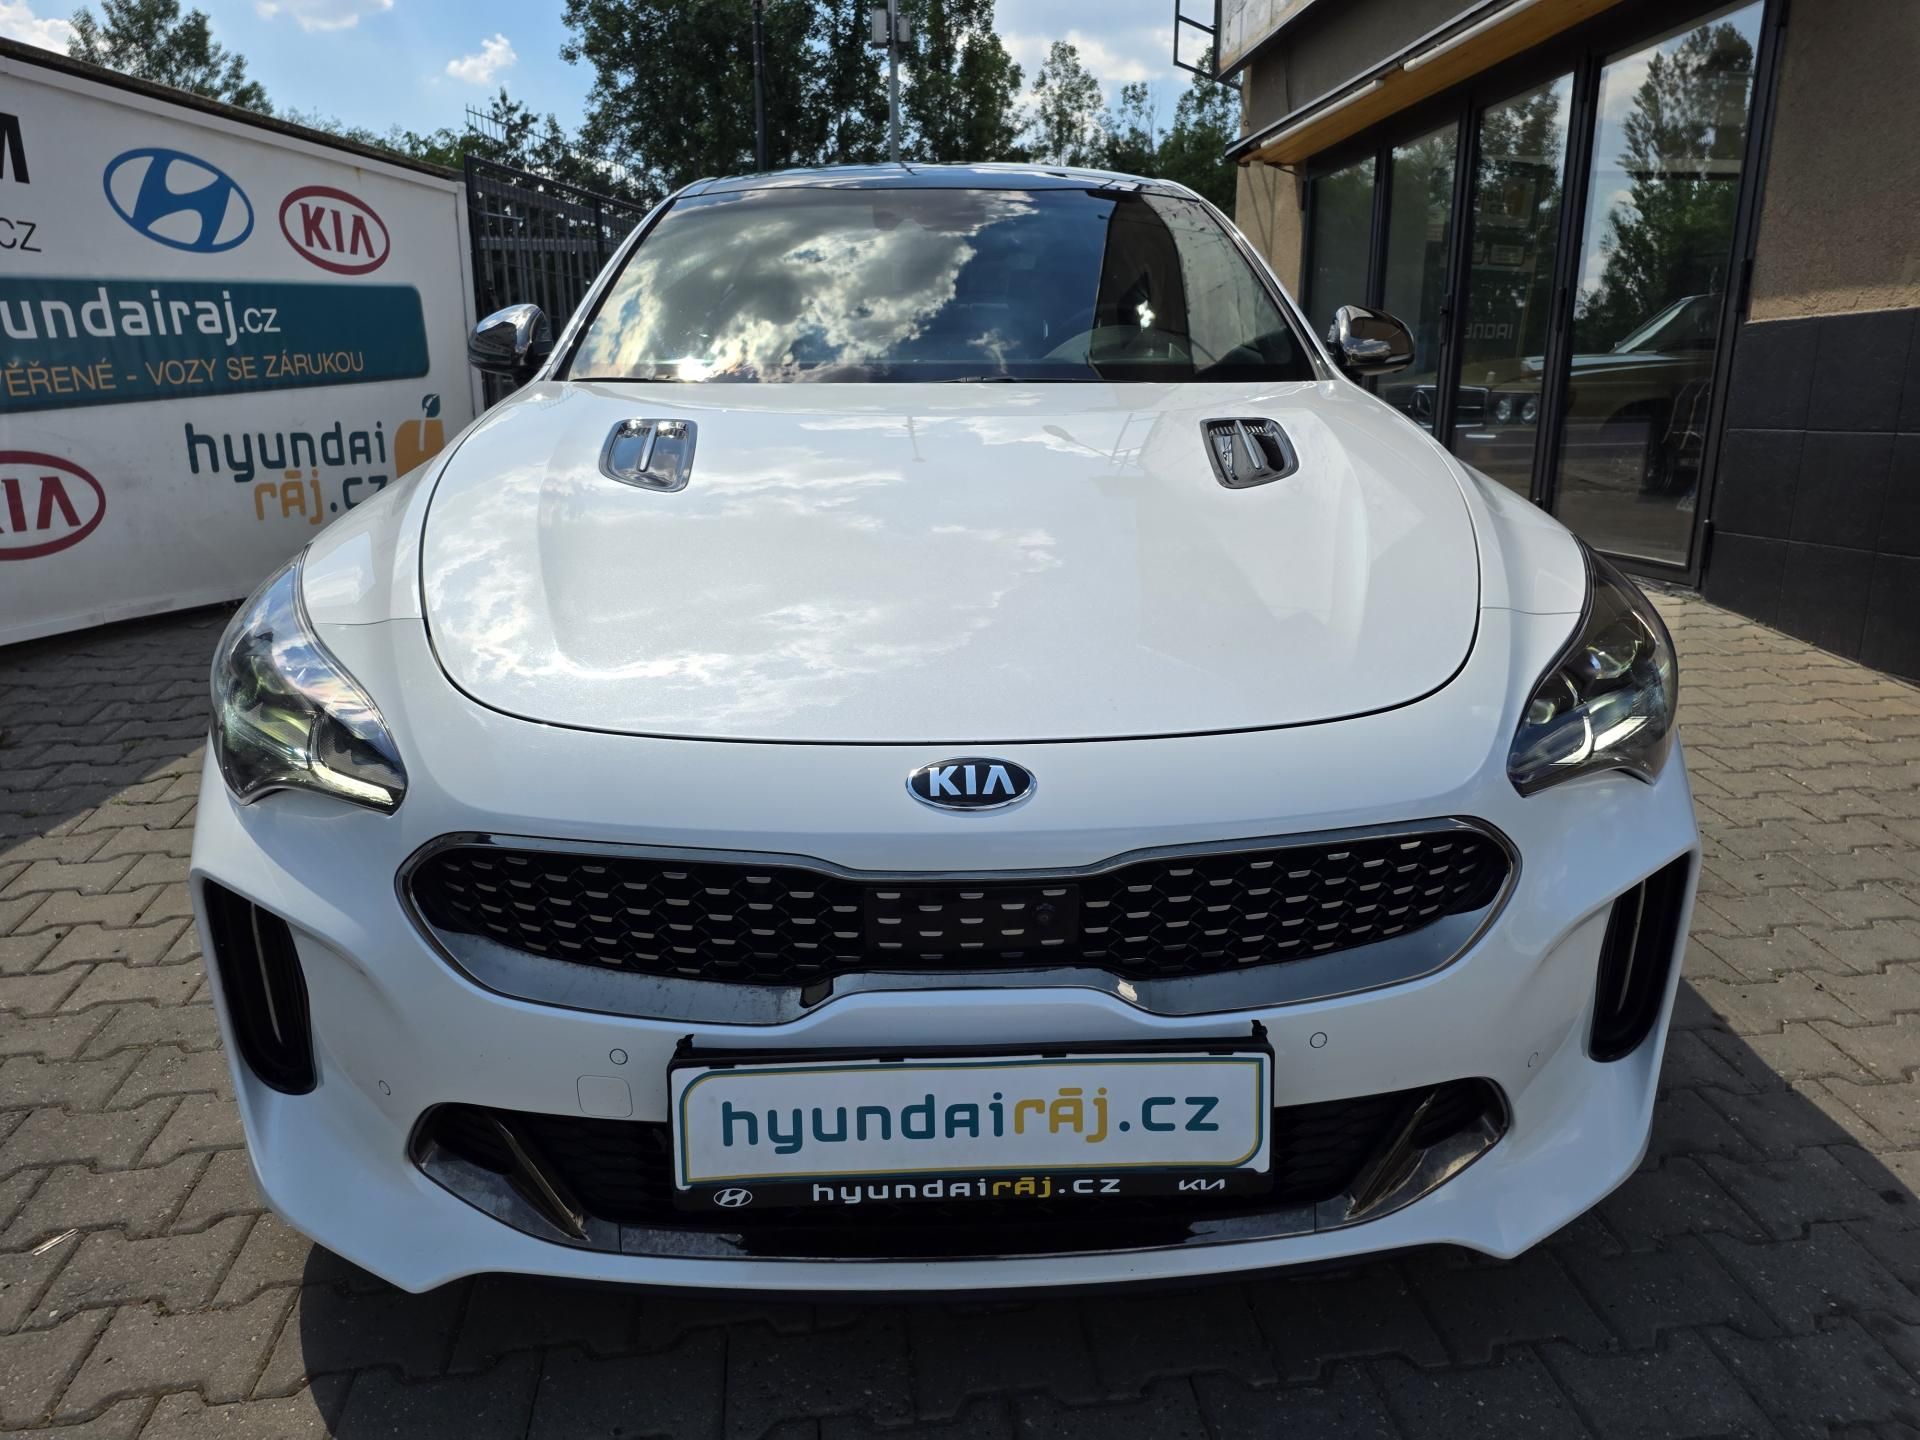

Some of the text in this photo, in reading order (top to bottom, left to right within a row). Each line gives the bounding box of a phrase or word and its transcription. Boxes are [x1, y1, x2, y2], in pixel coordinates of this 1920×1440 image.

[298, 202, 376, 259] KIA
[145, 358, 216, 386] VOZY
[226, 356, 258, 381] SE
[263, 349, 364, 378] ZÁRUKOU
[184, 421, 387, 483] hyundai
[0, 476, 82, 534] IA
[928, 764, 1016, 797] KIA
